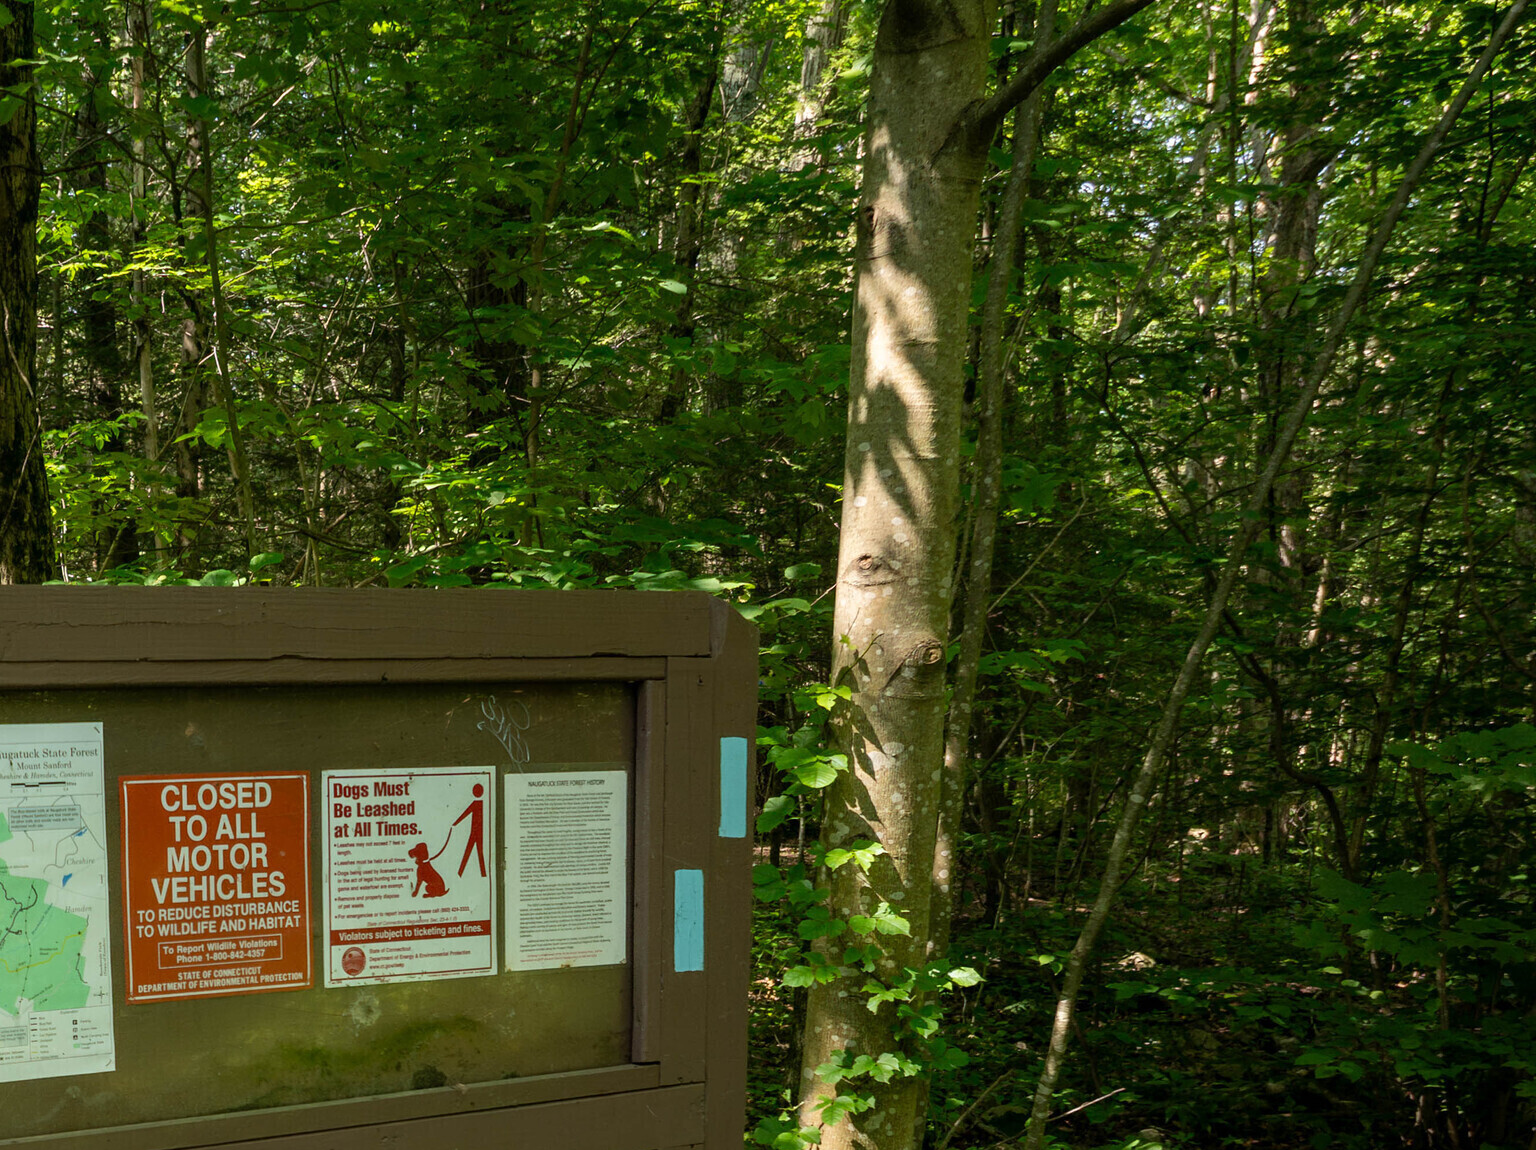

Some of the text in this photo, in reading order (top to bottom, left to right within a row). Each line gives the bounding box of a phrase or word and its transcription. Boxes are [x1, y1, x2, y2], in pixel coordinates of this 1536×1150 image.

[42, 748, 67, 758] State
[70, 747, 98, 757] Forest
[17, 760, 72, 770] Mount Sanford
[161, 782, 272, 812] CLOSED
[334, 781, 410, 800] Dogs Must
[334, 800, 415, 818] Be Leashed
[169, 812, 266, 842] TO ALL
[334, 821, 422, 838] at All Times.
[66, 857, 95, 865] Cheshire
[167, 842, 268, 872] MOTOR
[151, 871, 286, 904] VEHICLES
[137, 900, 300, 923] TO REDUCE DISTURBANCE
[136, 915, 301, 938] TO WILDLIFE AND HABITAT
[339, 932, 373, 941] Violators
[375, 930, 402, 940] subject
[405, 929, 412, 937] to
[414, 928, 446, 937] ticketing
[448, 925, 462, 933] and
[163, 939, 278, 955] To Report Wildlife Violations
[176, 949, 265, 964] Phone 1-800-842-4357
[138, 972, 303, 993] DEPARTMENT OF ENVIRONMENTAL PROTECTION
[178, 966, 262, 981] STATE OF CONNECTICUT
